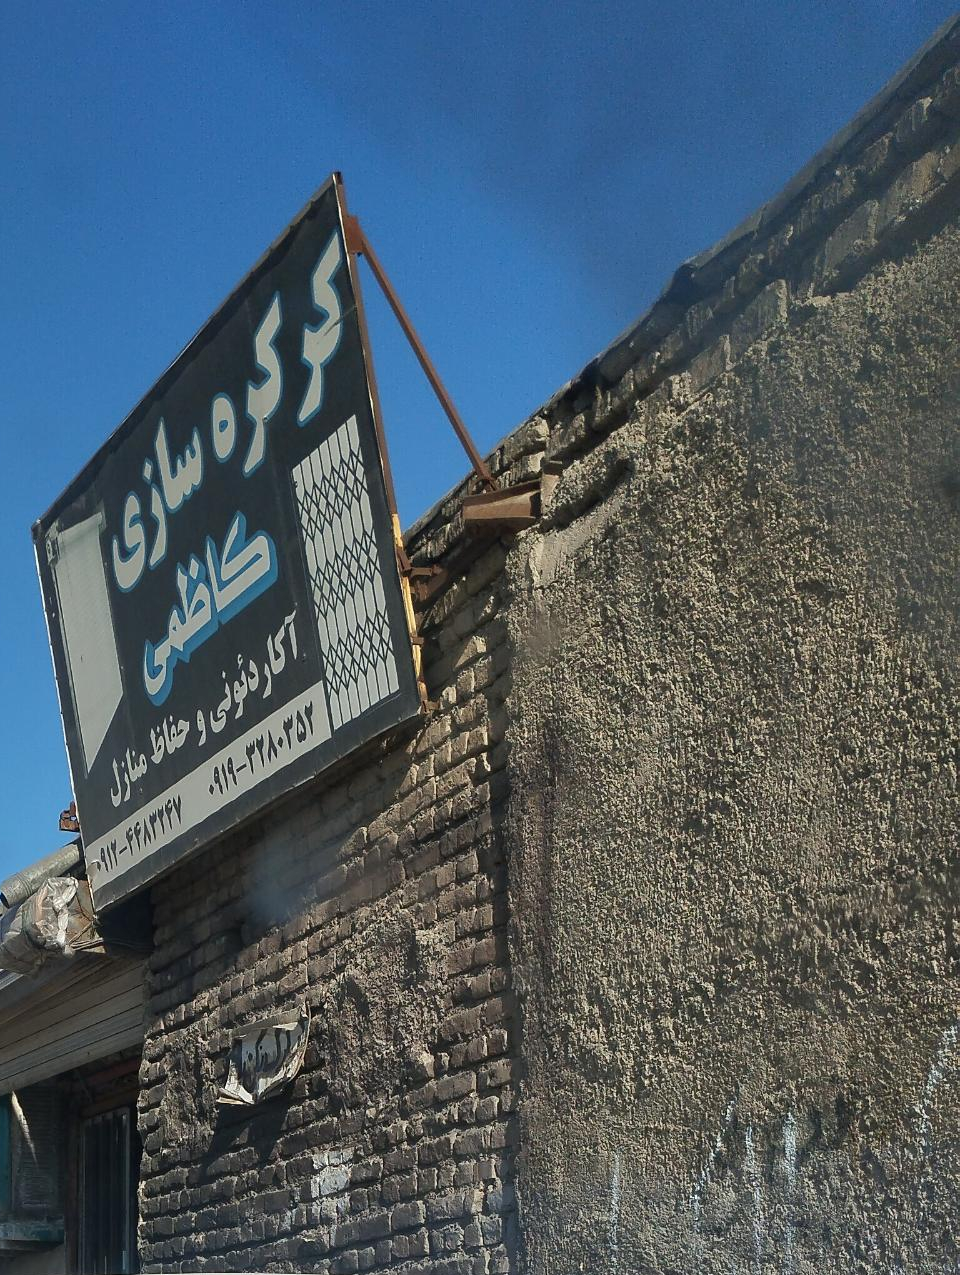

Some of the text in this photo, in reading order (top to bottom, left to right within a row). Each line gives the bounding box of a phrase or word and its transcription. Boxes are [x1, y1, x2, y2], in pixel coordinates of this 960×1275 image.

[112, 416, 203, 594] سازی
[143, 510, 279, 706] کاظمی
[150, 714, 190, 765] حفاظ
[195, 708, 207, 747] و
[110, 747, 148, 808] منازل
